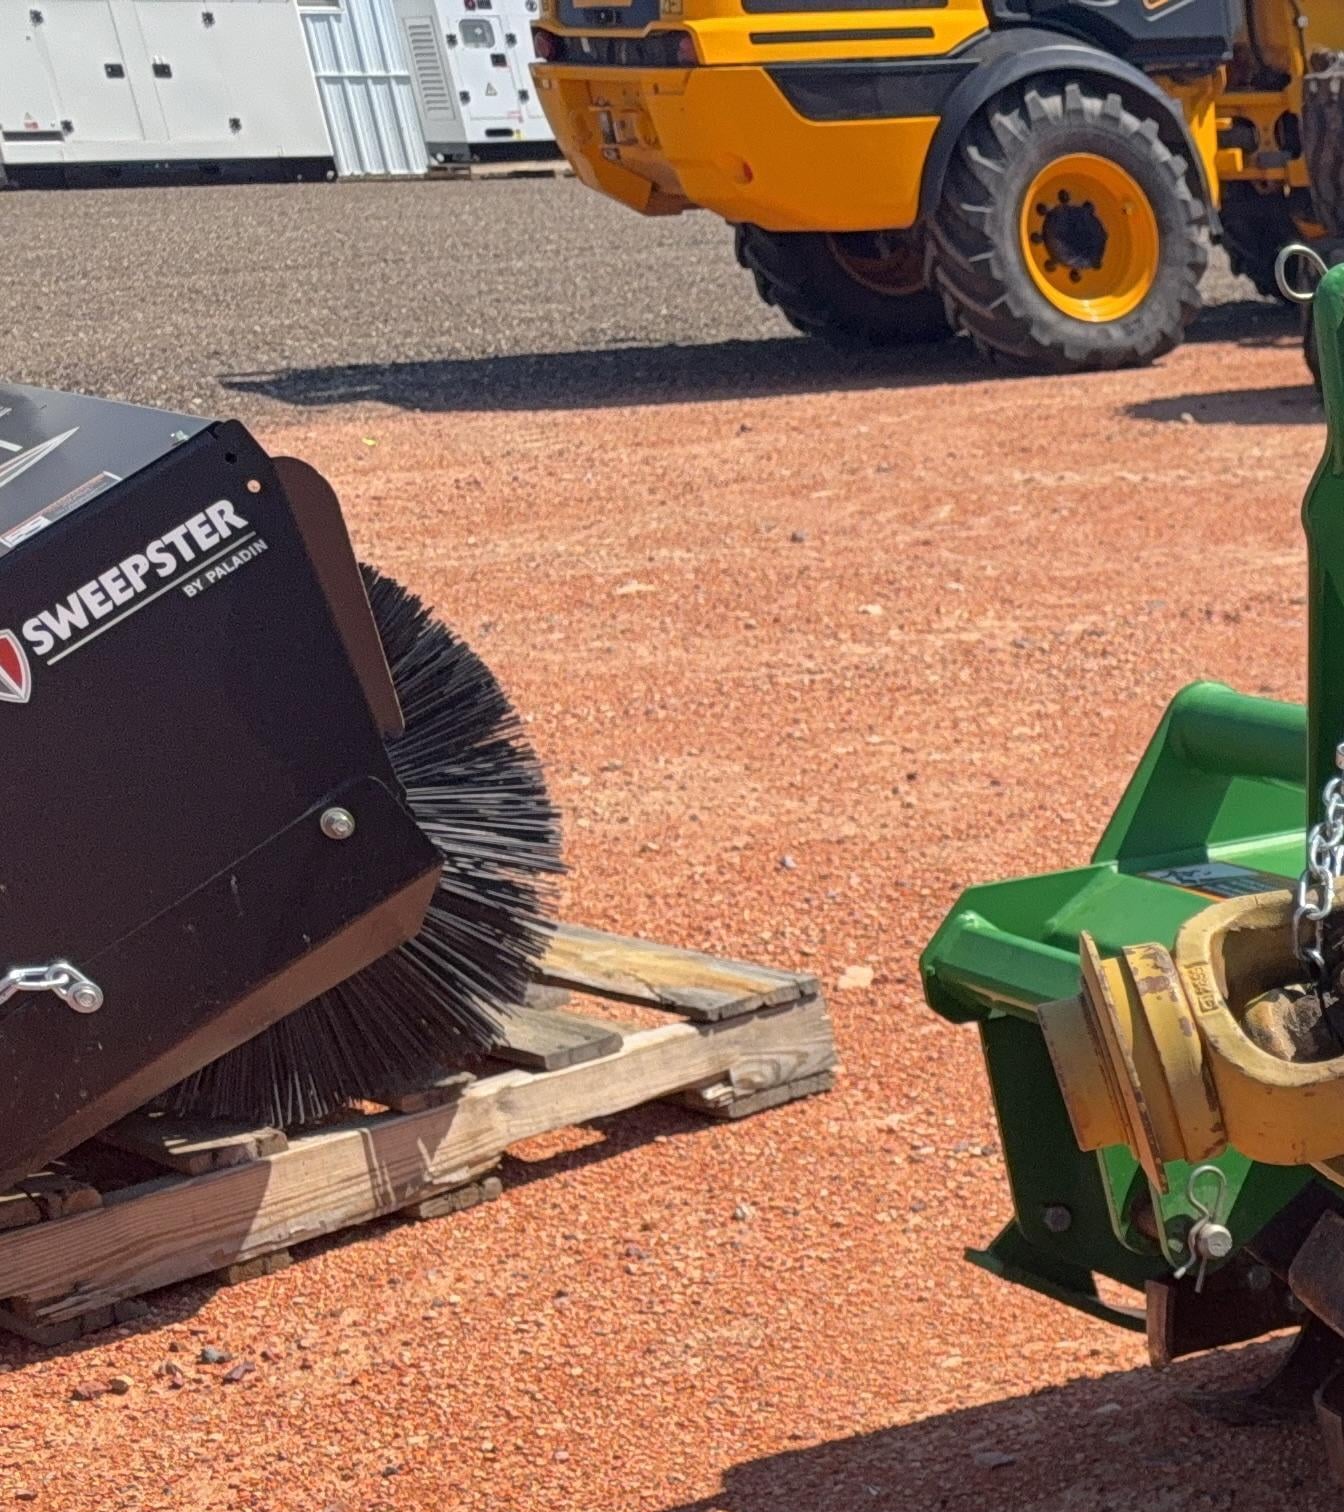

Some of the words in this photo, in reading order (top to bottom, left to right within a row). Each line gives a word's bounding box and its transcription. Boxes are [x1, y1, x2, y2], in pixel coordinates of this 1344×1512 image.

[22, 499, 249, 656] SWEEPSTER
[182, 578, 204, 598] BY
[205, 539, 268, 583] PALADIN
